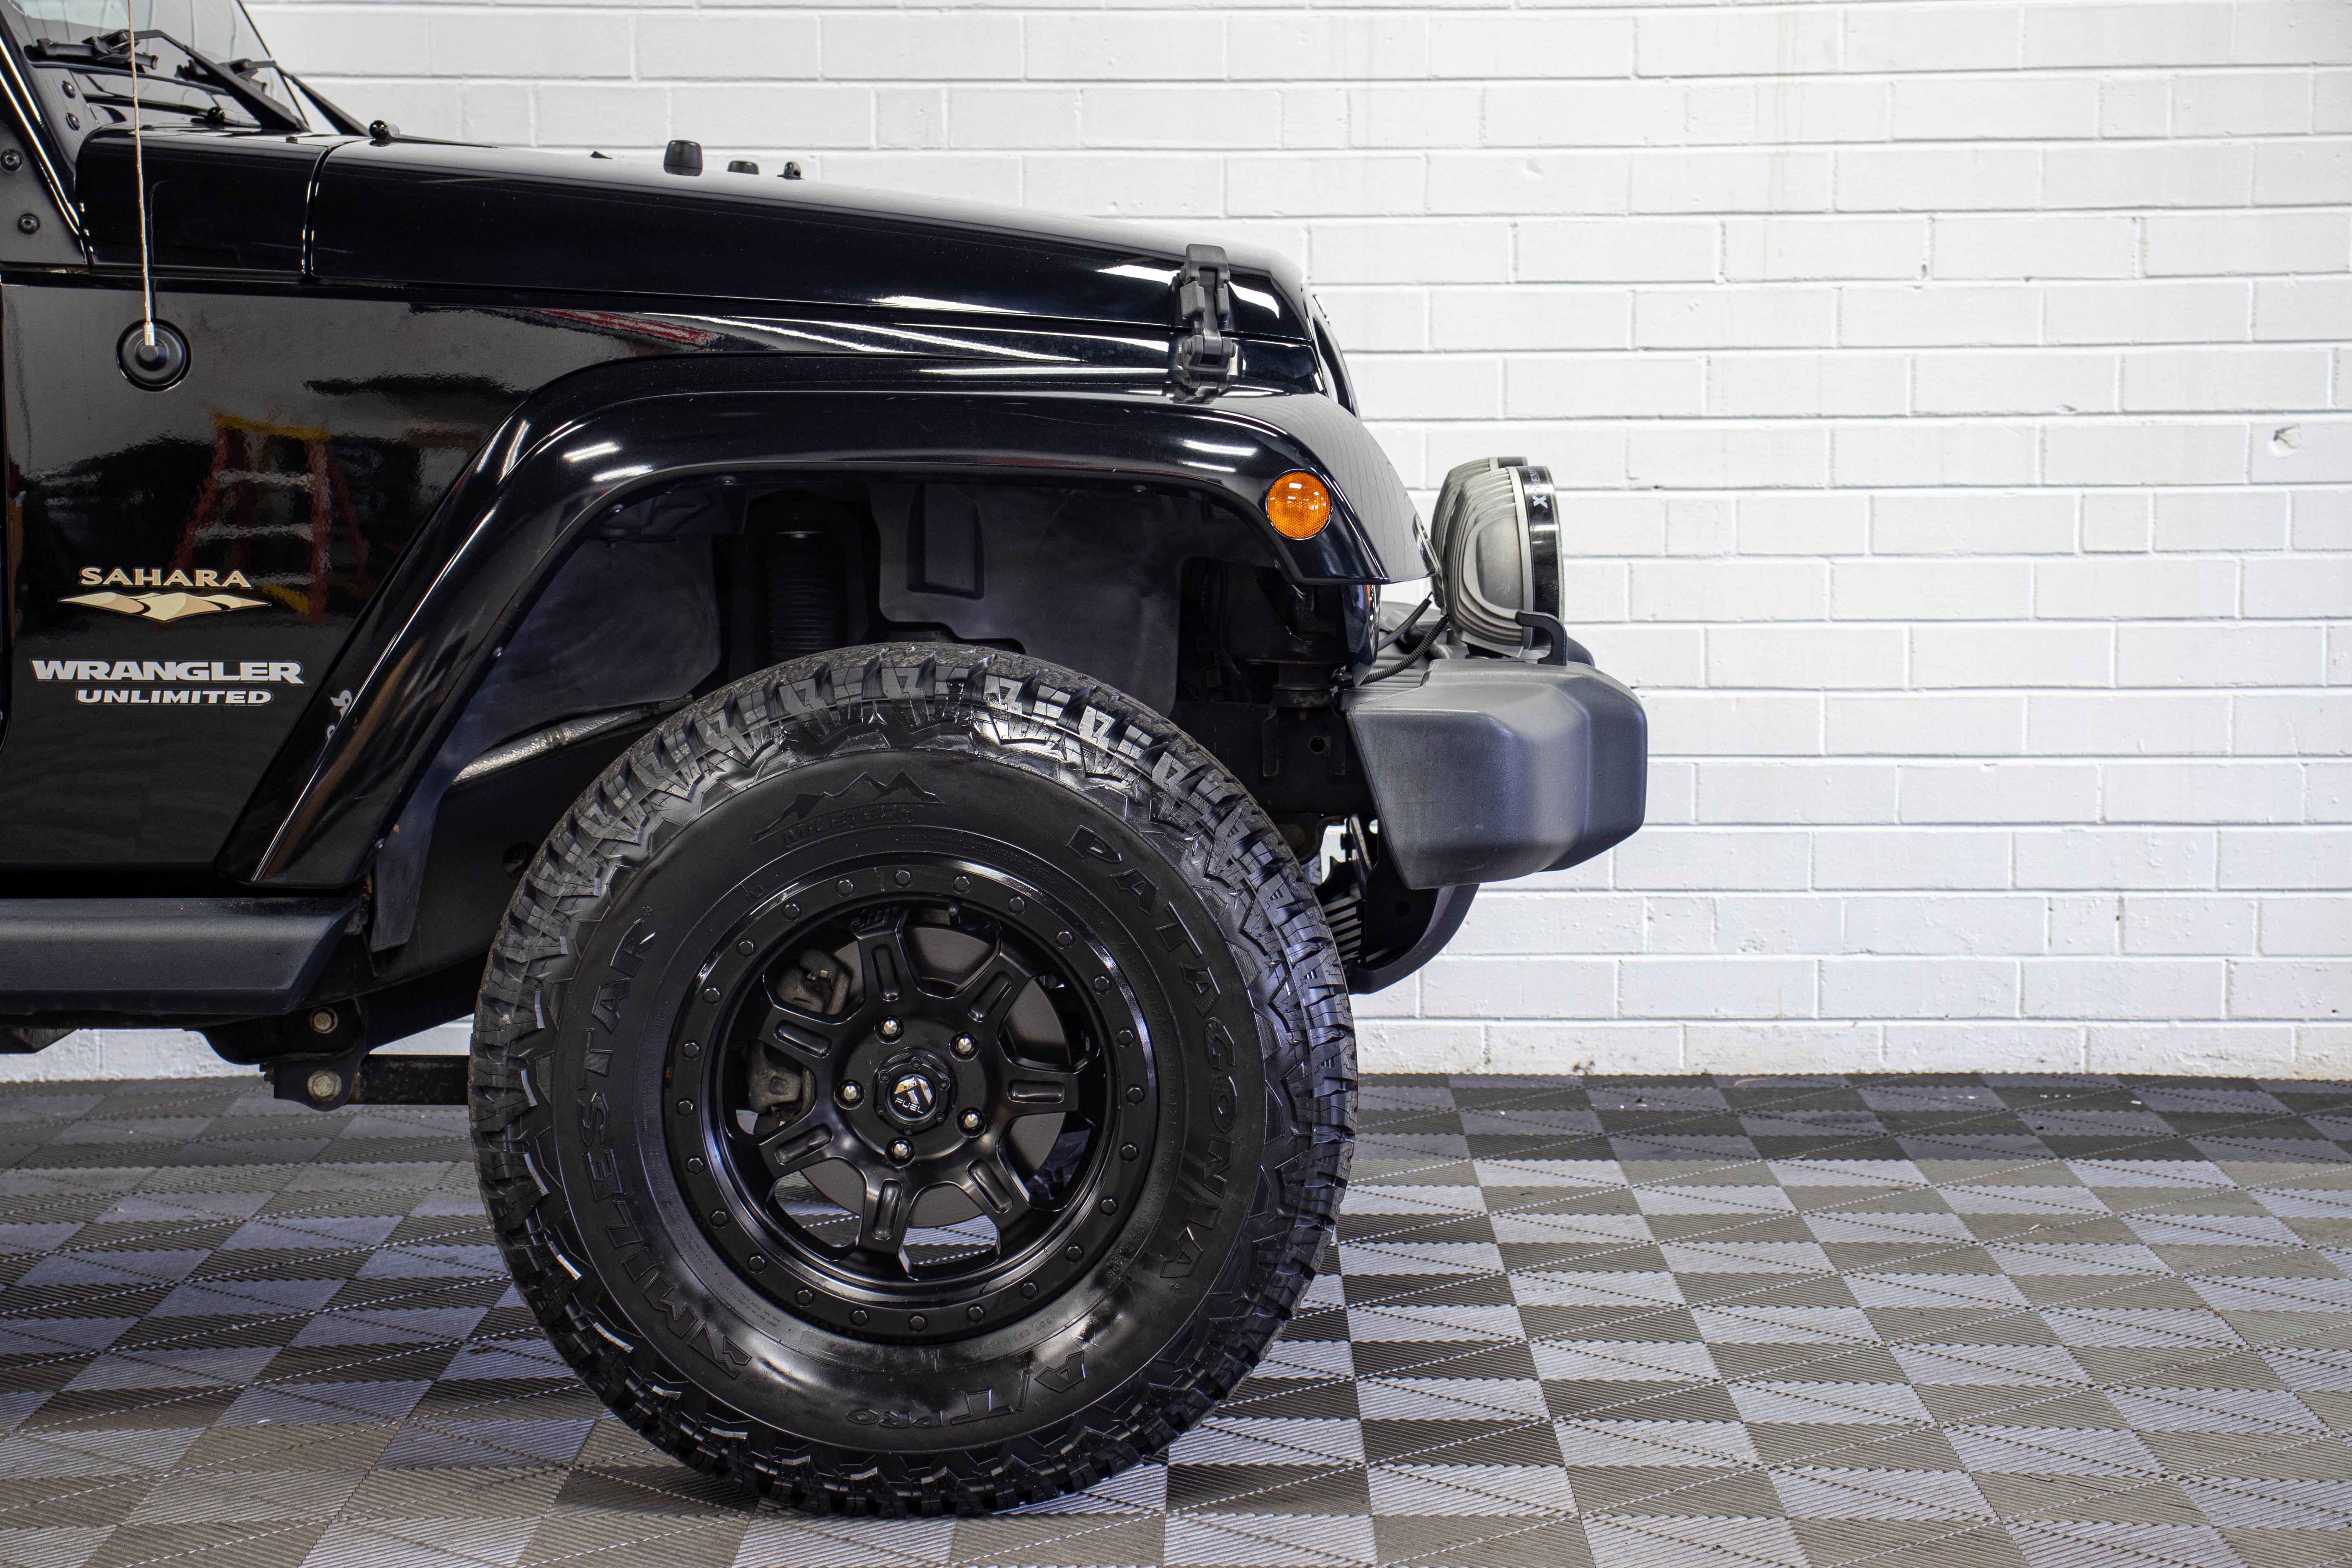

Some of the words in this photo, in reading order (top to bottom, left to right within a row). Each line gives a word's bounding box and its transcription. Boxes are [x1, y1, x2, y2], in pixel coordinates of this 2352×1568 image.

[80, 567, 253, 588] SAHARA
[31, 659, 305, 684] WRANGLER
[77, 689, 273, 704] UNLIMITED
[1067, 825, 1237, 1278] PATAGONIA
[895, 1098, 924, 1114] FUEL
[577, 919, 698, 1338] MILESTAR
[950, 1350, 1086, 1425] A/T
[846, 1408, 943, 1429] PRO
